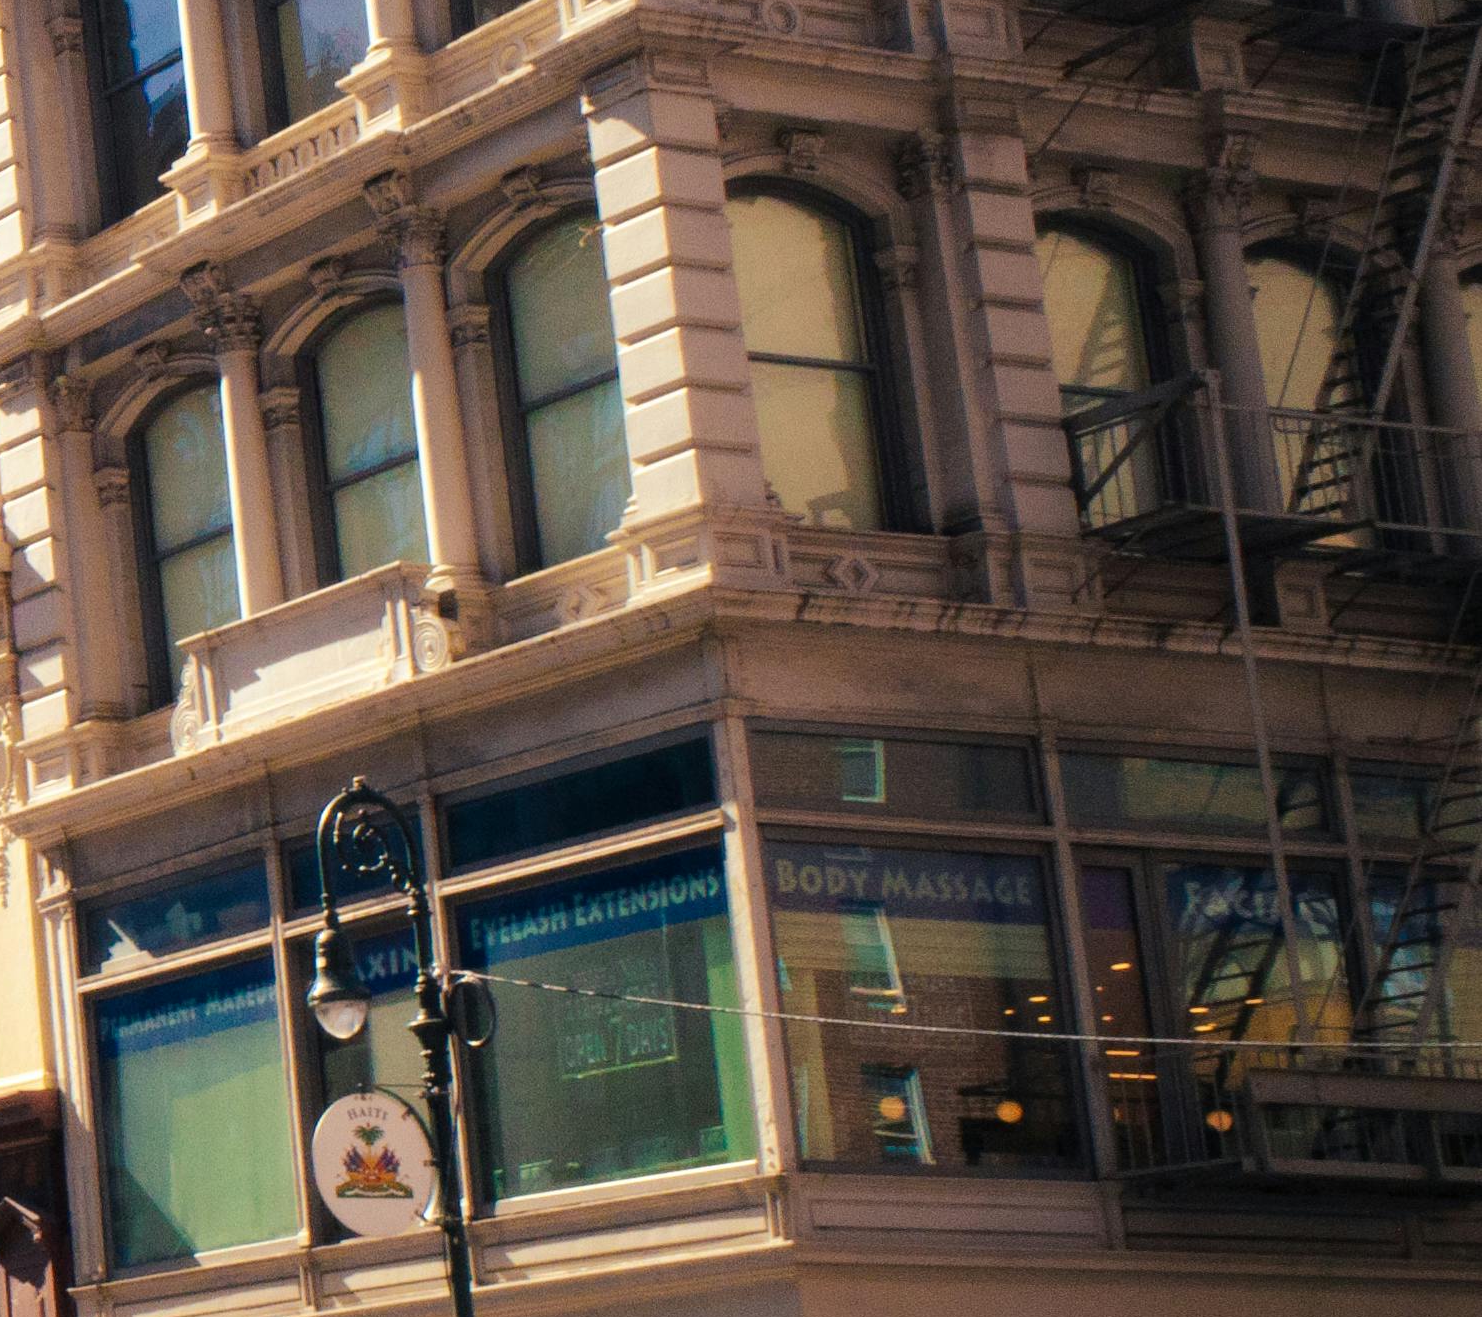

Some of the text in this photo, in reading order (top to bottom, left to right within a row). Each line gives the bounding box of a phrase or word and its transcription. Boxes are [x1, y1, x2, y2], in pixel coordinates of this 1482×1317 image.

[470, 869, 720, 951] EYELASH EXTENSIONS
[775, 858, 1032, 905] BODY MASSAGE
